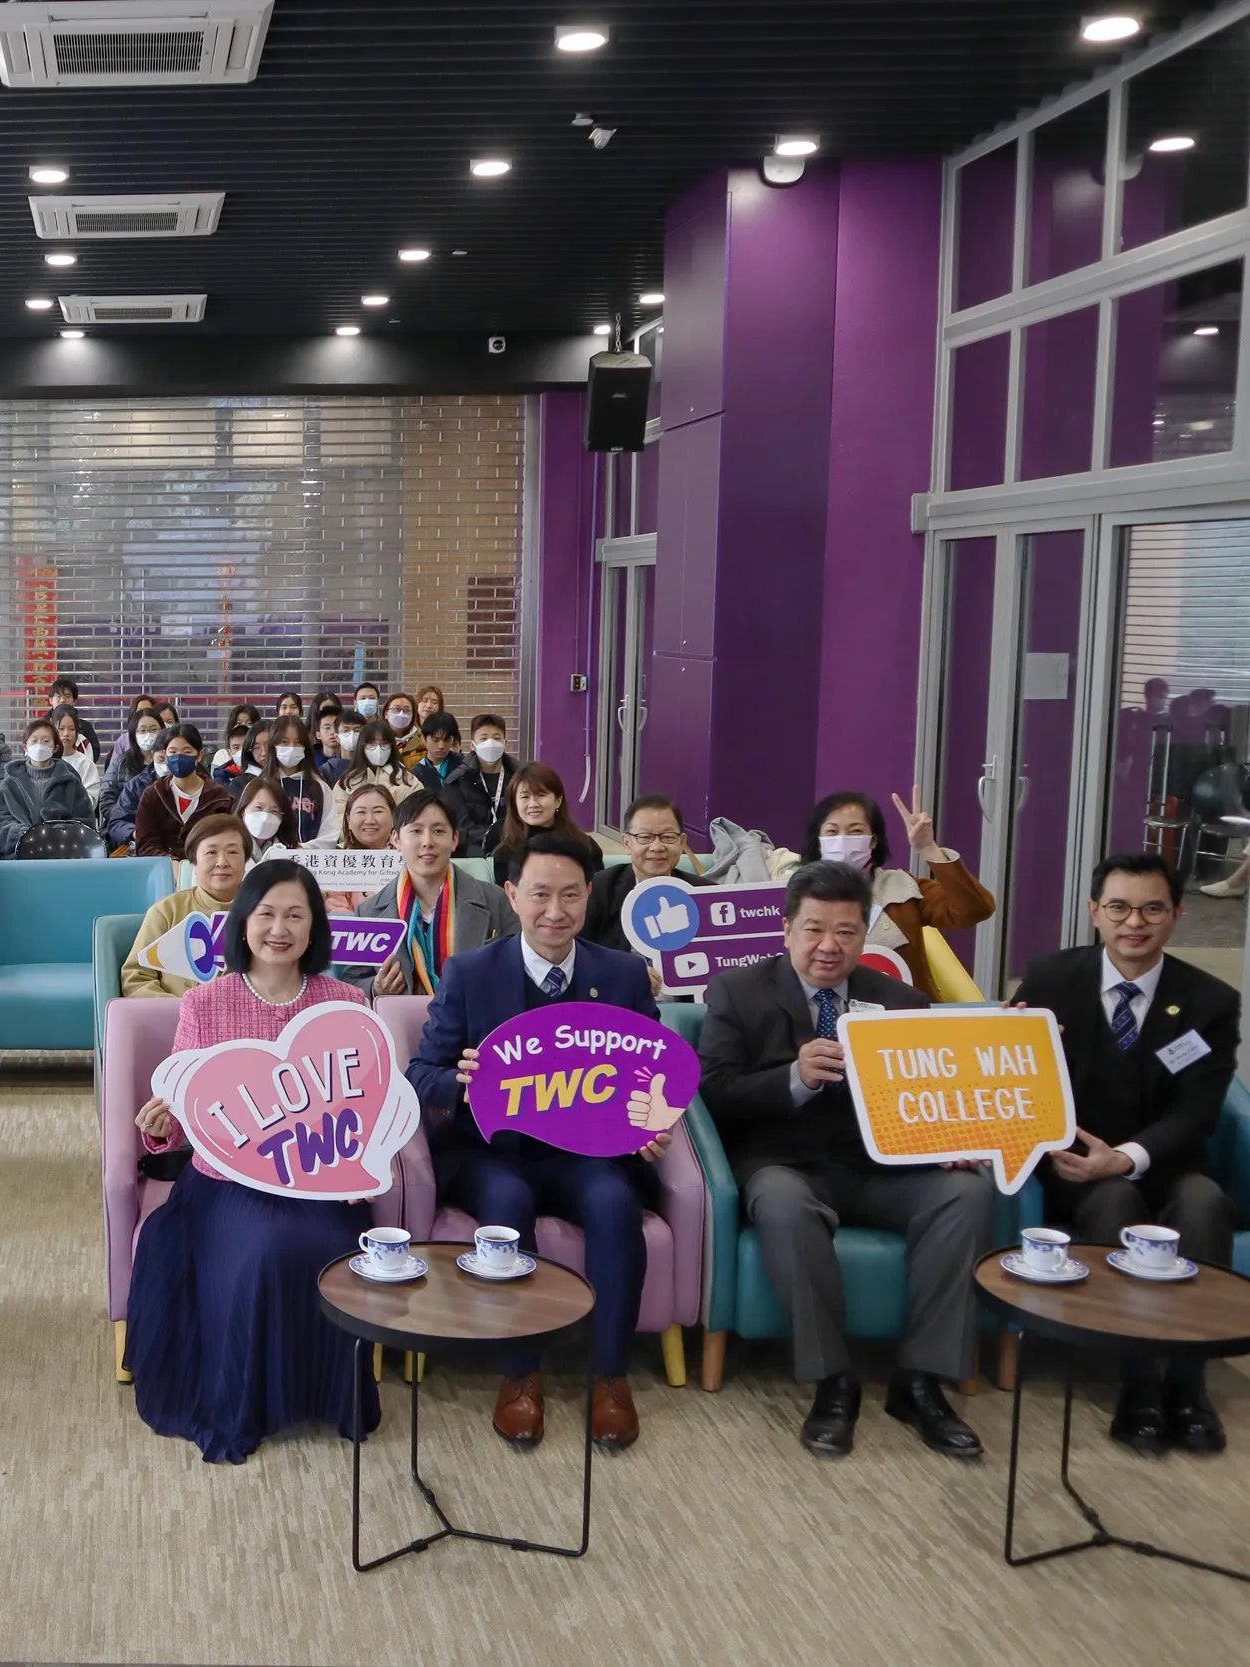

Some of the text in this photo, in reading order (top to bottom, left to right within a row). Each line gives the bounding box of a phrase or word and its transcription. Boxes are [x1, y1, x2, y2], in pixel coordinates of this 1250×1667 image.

[739, 905, 781, 919] twchk
[331, 931, 391, 952] TWC
[492, 1025, 667, 1065] We Support
[876, 1045, 1038, 1080] TUNG WAH
[207, 1047, 365, 1149] I LOVE
[500, 1064, 618, 1117] TWC
[898, 1088, 1035, 1123] COLLEGE
[256, 1108, 363, 1187] TWC
